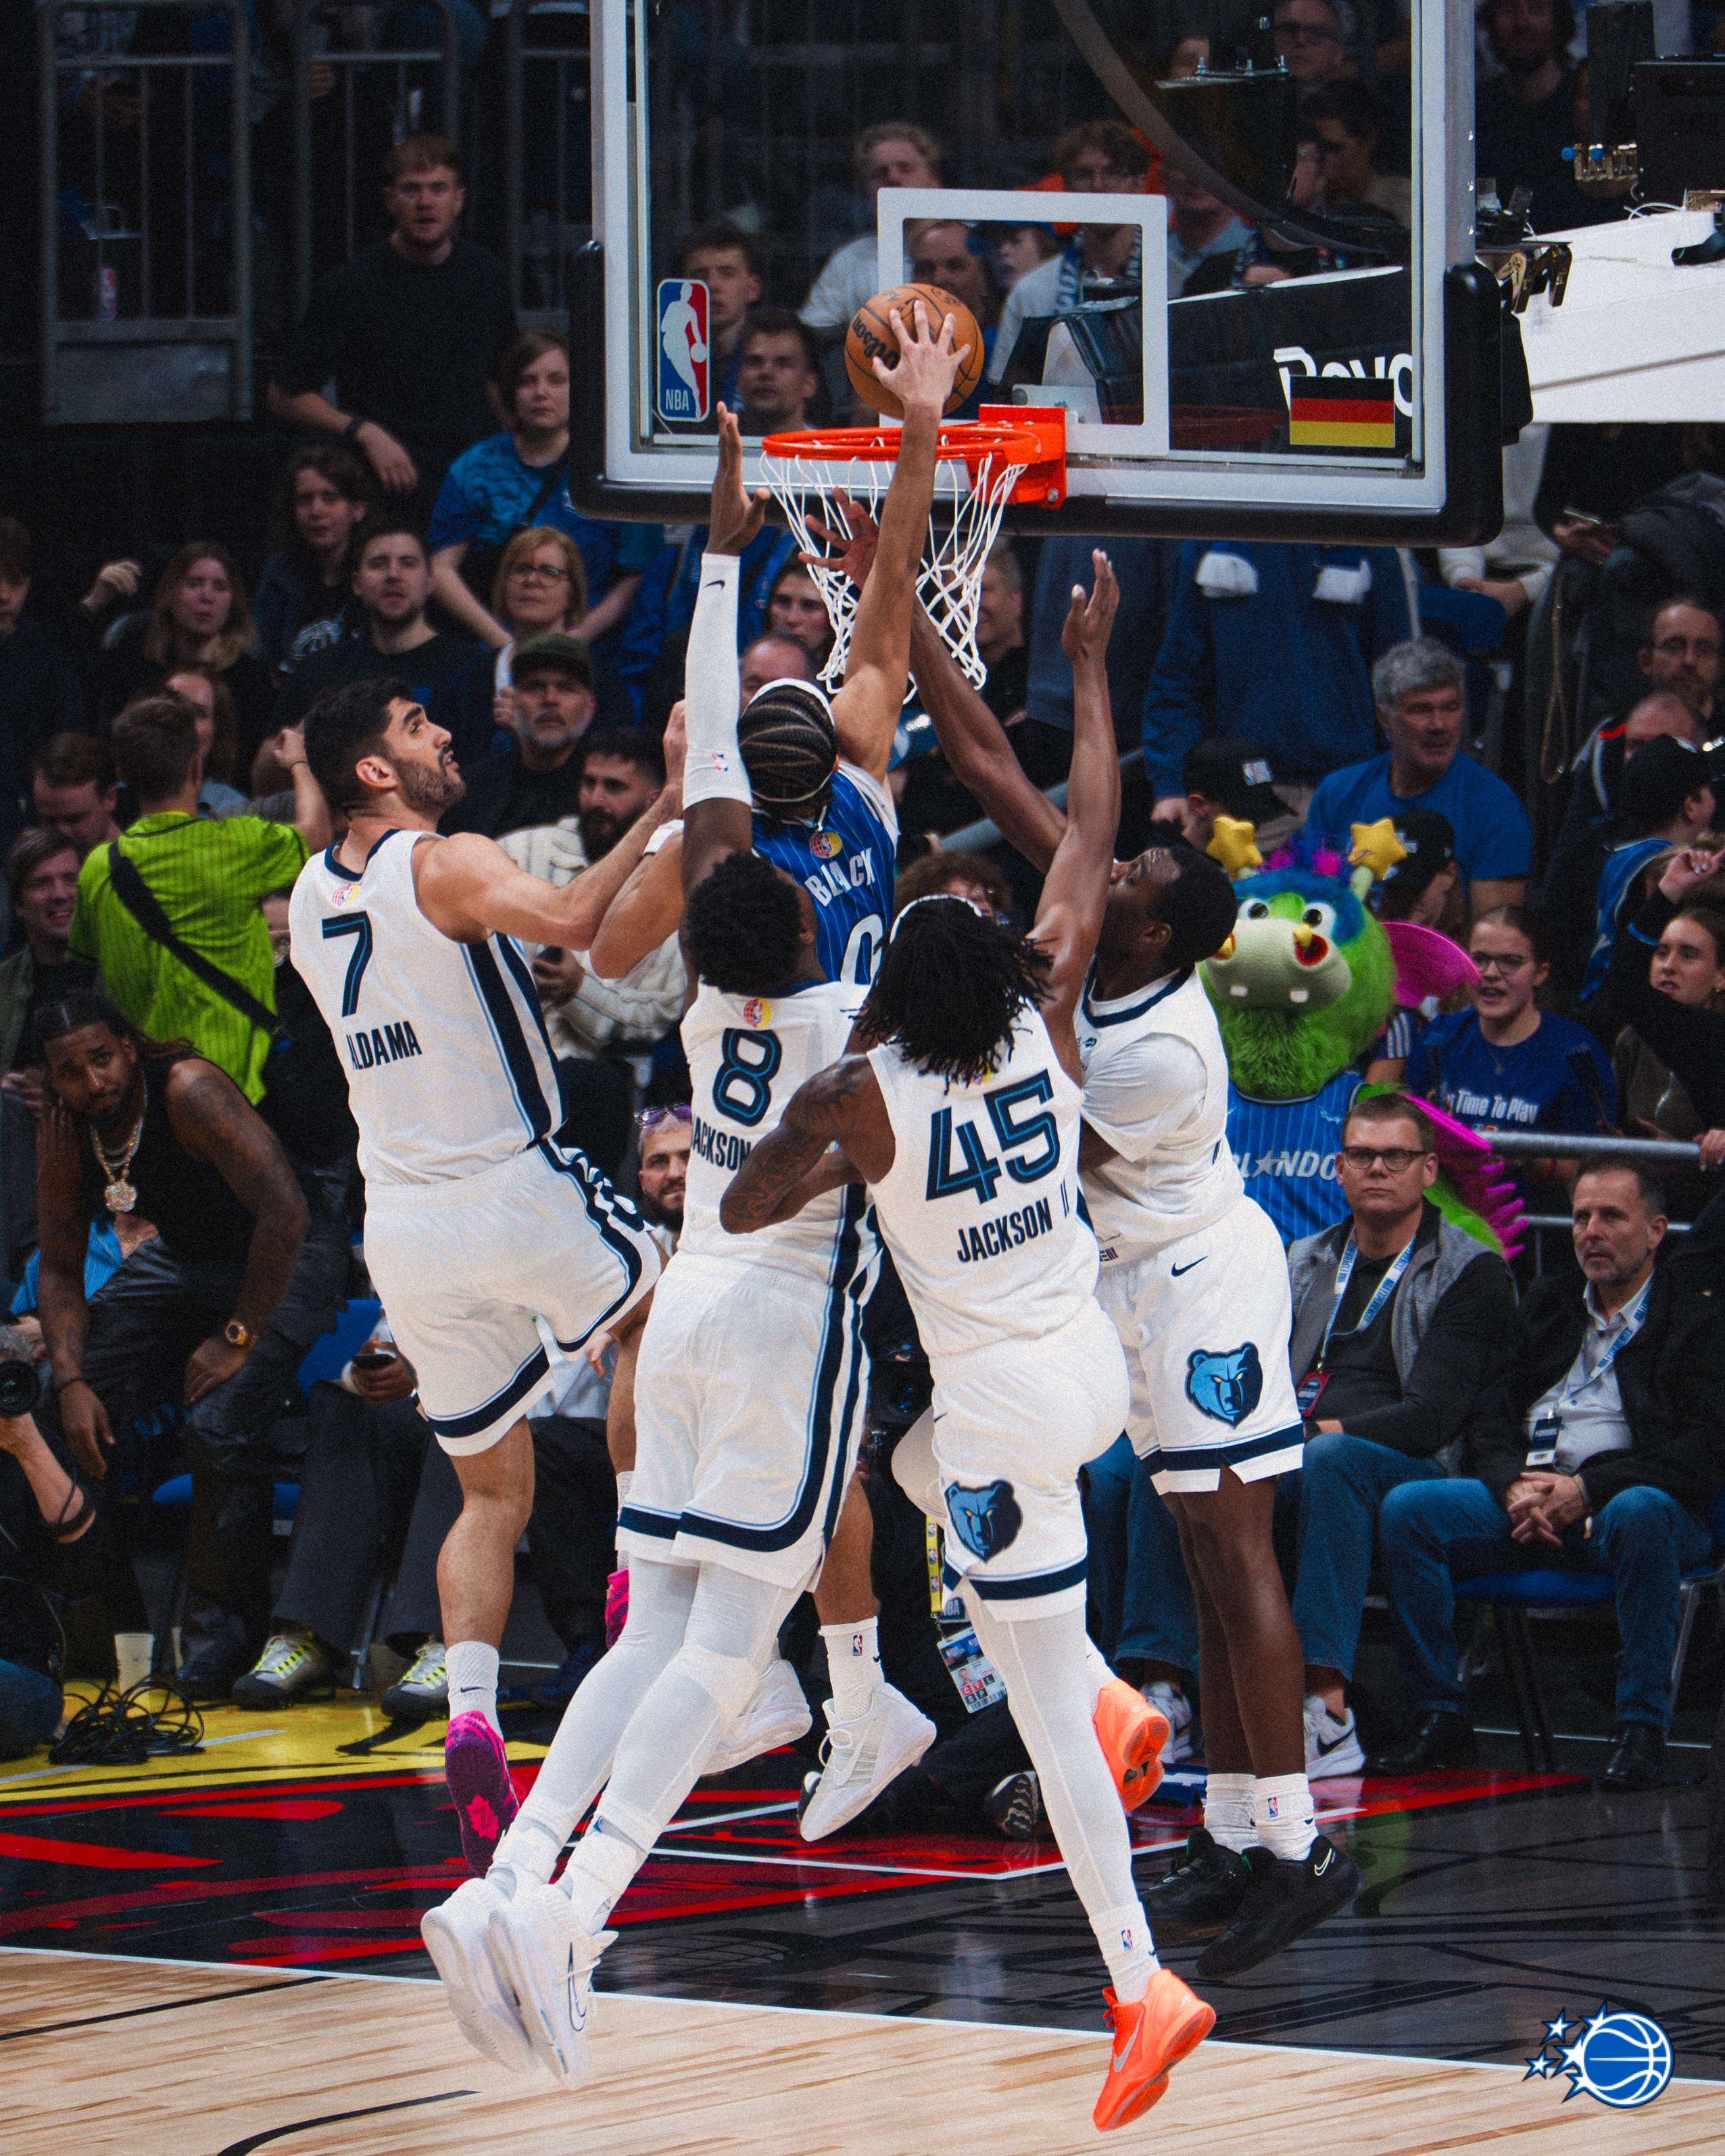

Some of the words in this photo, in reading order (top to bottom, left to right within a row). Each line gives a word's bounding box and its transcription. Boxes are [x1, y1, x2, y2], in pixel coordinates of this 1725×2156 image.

[665, 389, 689, 411] NBA
[321, 911, 373, 1017] 7
[712, 1027, 783, 1128] 8
[1456, 1090, 1490, 1116] Time
[692, 1116, 752, 1172] ACKSON
[925, 1068, 1061, 1205] 45
[956, 1197, 1053, 1263] JACKSON
